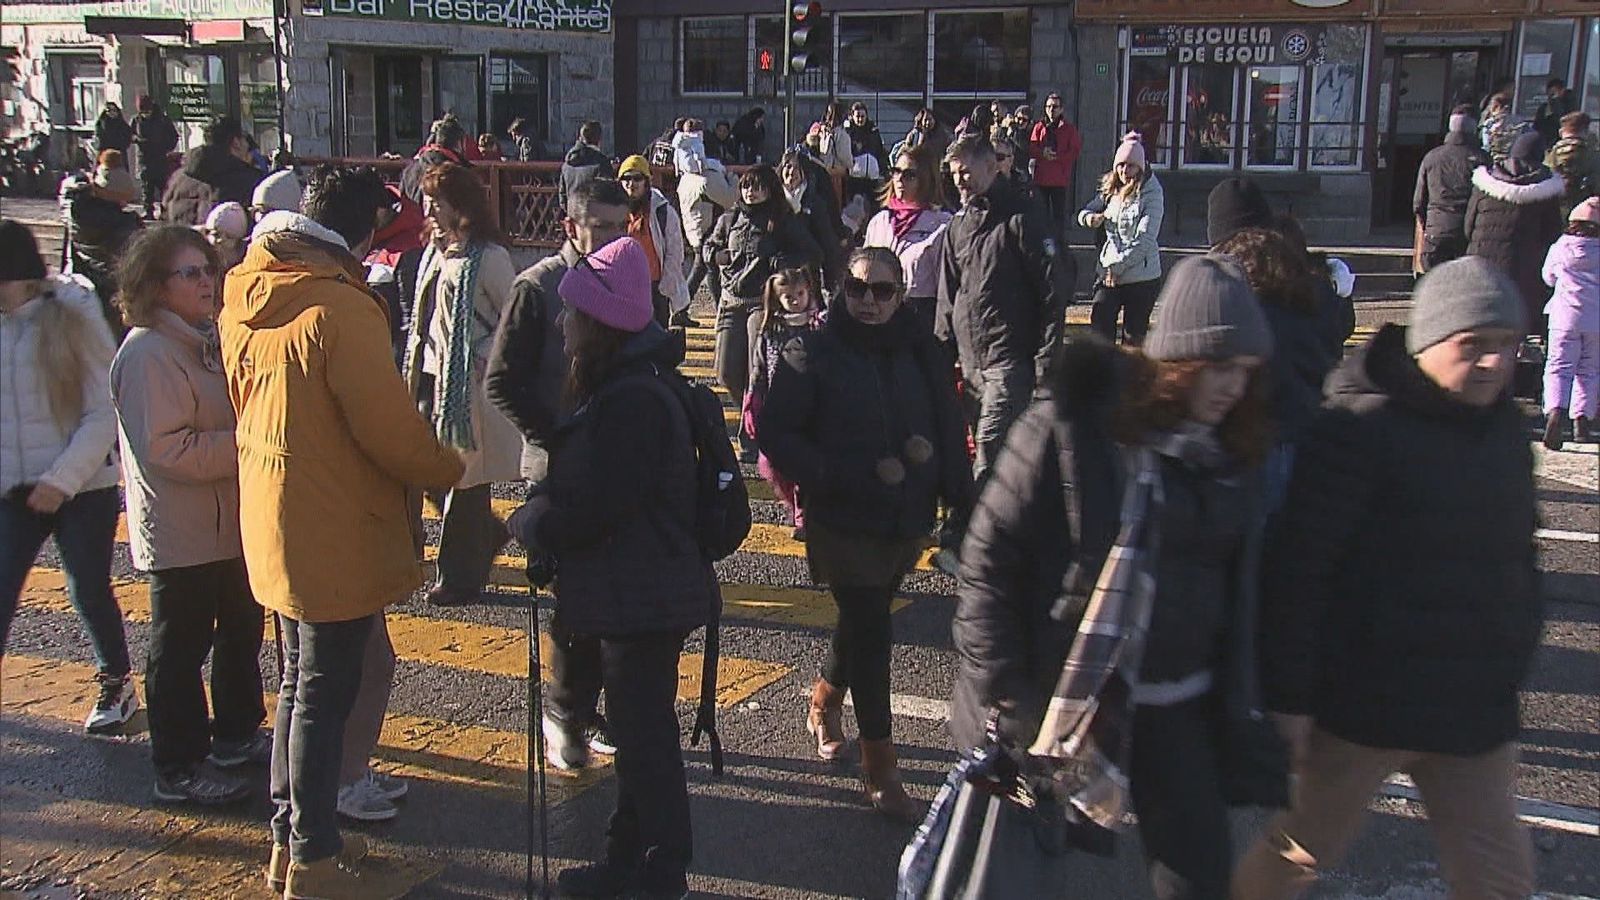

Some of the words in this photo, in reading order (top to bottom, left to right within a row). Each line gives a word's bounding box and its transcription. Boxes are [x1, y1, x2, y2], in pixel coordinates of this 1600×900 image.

[1183, 26, 1272, 45] ESCUELA
[1178, 46, 1206, 63] DE
[1213, 46, 1276, 63] ESQUI
